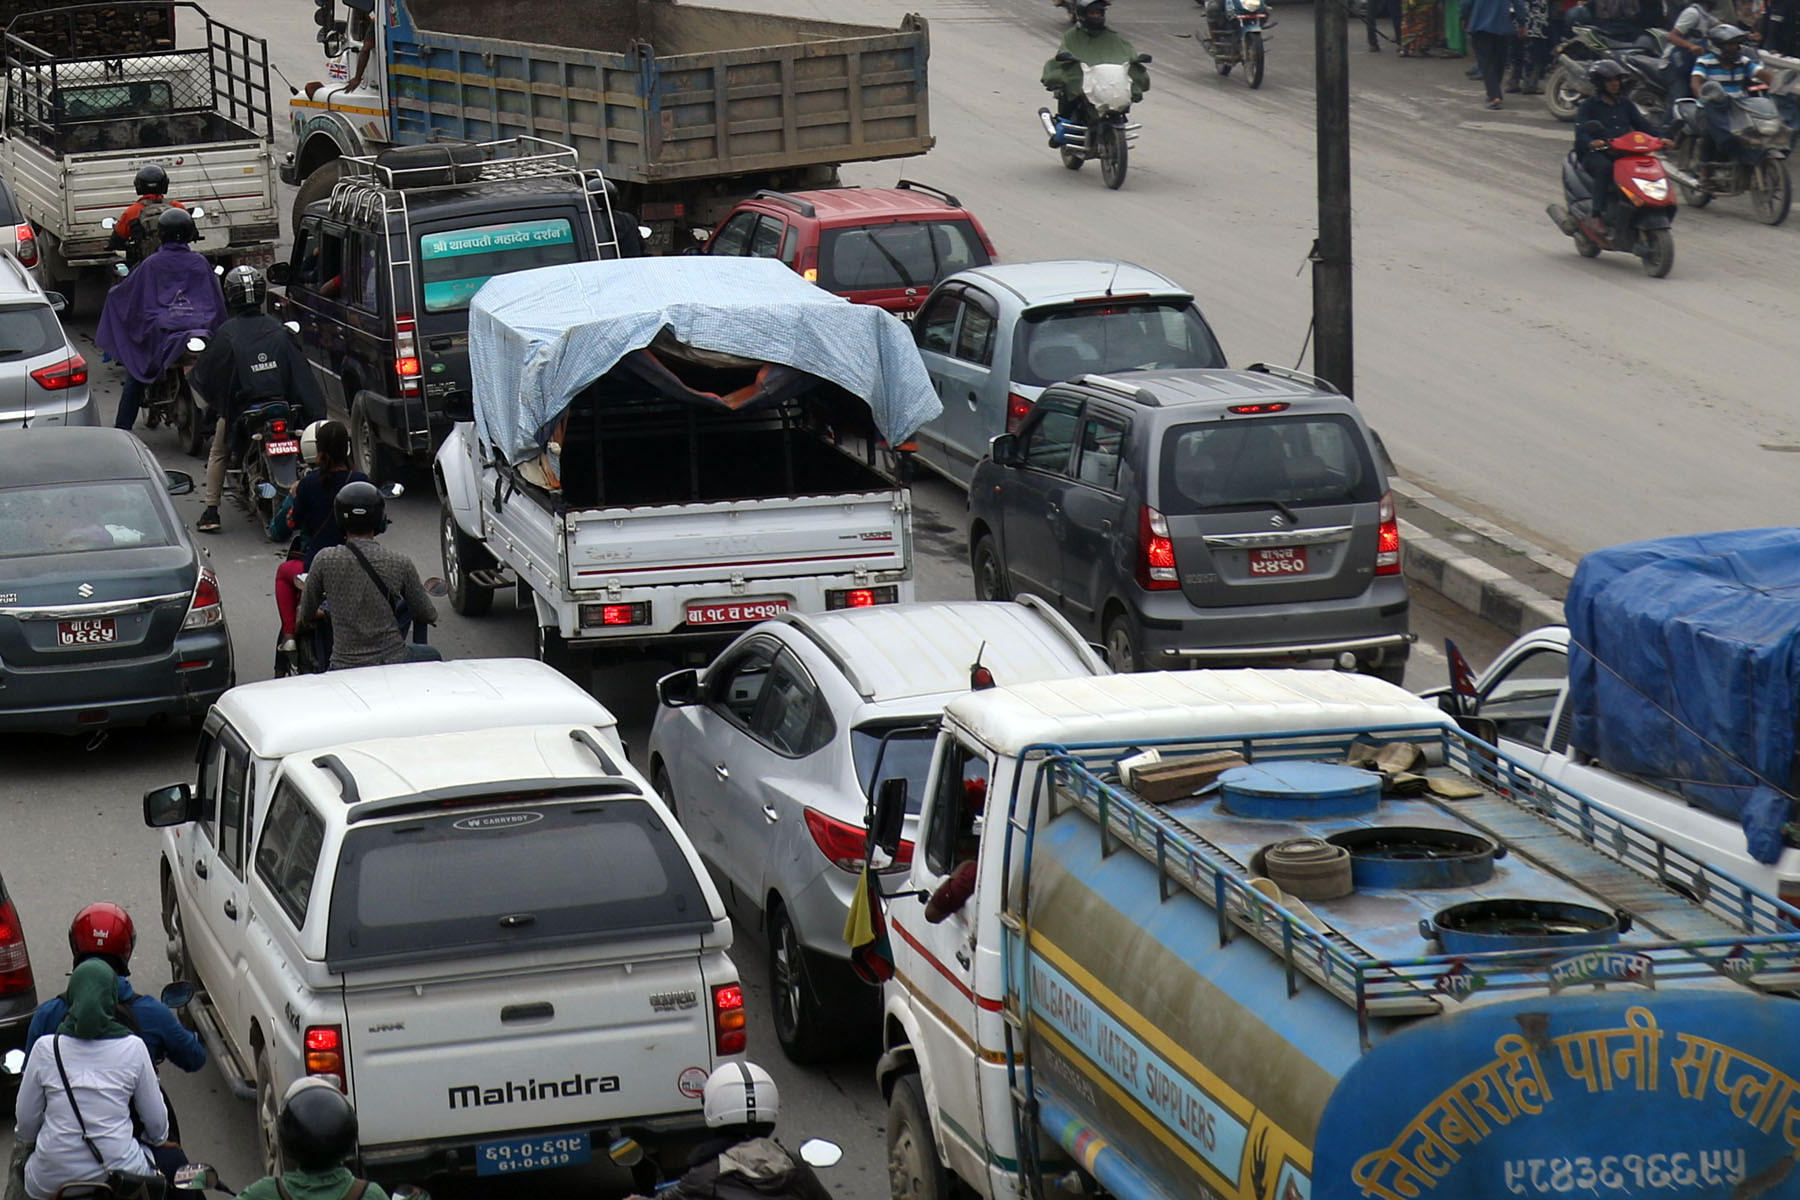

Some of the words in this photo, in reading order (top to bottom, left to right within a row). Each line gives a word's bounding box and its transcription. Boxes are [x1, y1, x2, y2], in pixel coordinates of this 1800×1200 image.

[433, 240, 448, 254] श्री
[449, 236, 491, 249] थानपती
[494, 231, 530, 244] महादेव
[533, 226, 560, 239] दर्शन
[250, 361, 278, 373] YAMAHA
[1252, 559, 1305, 573] ९४६०
[61, 628, 114, 644] ७६६५
[483, 815, 528, 825] CARRYBOY
[1032, 964, 1092, 1049] NILBARAHI
[1097, 1017, 1139, 1090] WATER
[1146, 1061, 1217, 1152] SUPPLIERS
[1553, 1006, 1664, 1092] पानी
[448, 1073, 621, 1109] Mahindra
[498, 1153, 570, 1171] 61-0-619
